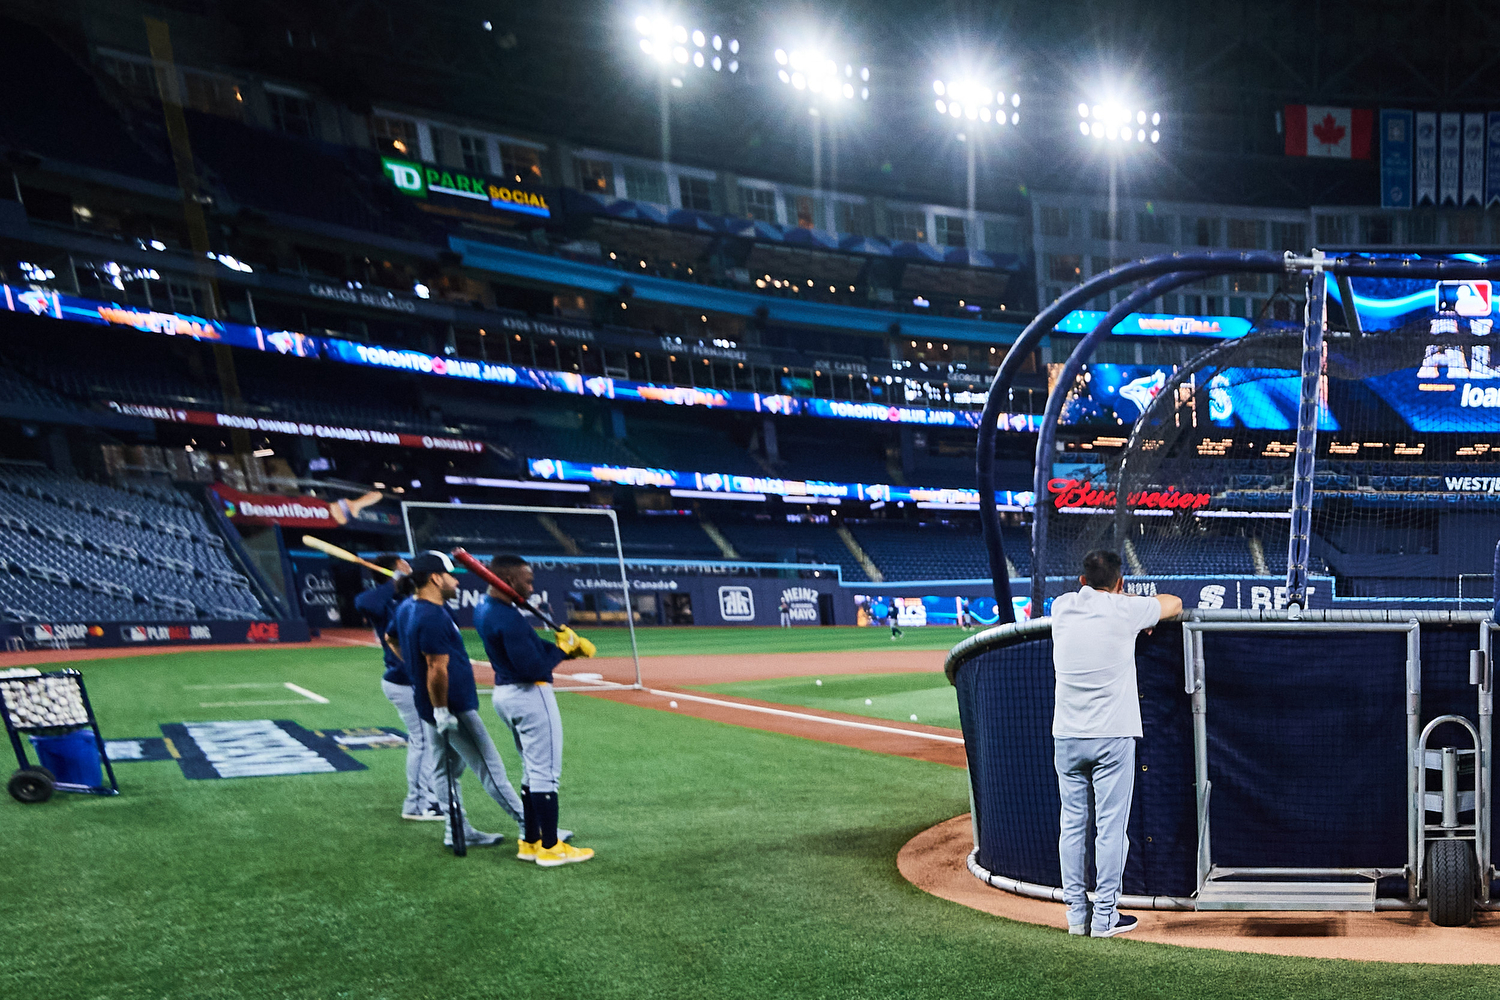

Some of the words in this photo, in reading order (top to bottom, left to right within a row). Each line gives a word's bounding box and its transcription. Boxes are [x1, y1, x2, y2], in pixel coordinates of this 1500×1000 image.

[385, 163, 421, 191] TD
[426, 168, 487, 197] PARK
[488, 185, 550, 210] SOCIAL
[357, 346, 433, 373] TORONTO
[483, 364, 517, 384] JAYS
[216, 413, 258, 430] PROUD
[258, 419, 299, 435] OWNER
[830, 401, 888, 421] TORONTO
[899, 408, 928, 424] BLUE
[928, 411, 956, 426] JAYS
[783, 587, 819, 604] HEINZ
[1198, 585, 1226, 610] S
[790, 608, 817, 621] MAYO
[246, 621, 279, 639] ACE
